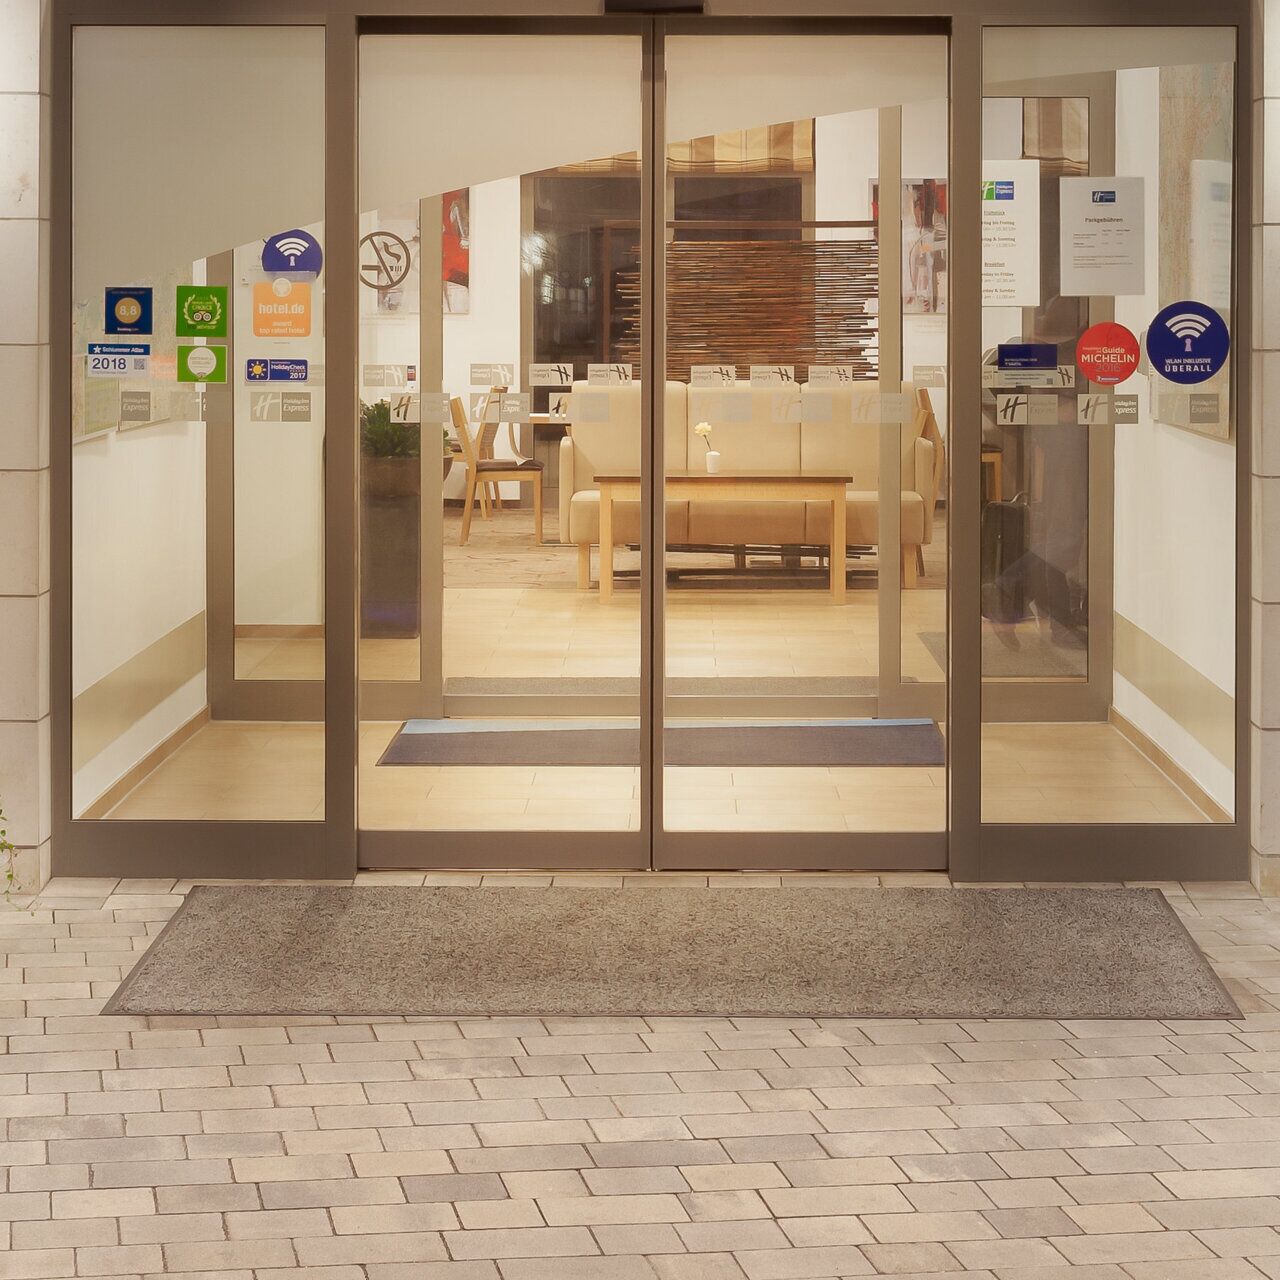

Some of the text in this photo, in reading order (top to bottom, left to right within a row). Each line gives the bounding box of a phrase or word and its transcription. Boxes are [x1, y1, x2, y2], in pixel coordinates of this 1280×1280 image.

[258, 303, 305, 314] hotel.de
[1102, 346, 1125, 354] Guide
[1081, 353, 1135, 363] MICHELIN
[92, 357, 127, 370] 2018
[1164, 363, 1212, 372] ÜBERALL
[283, 403, 309, 413] Express
